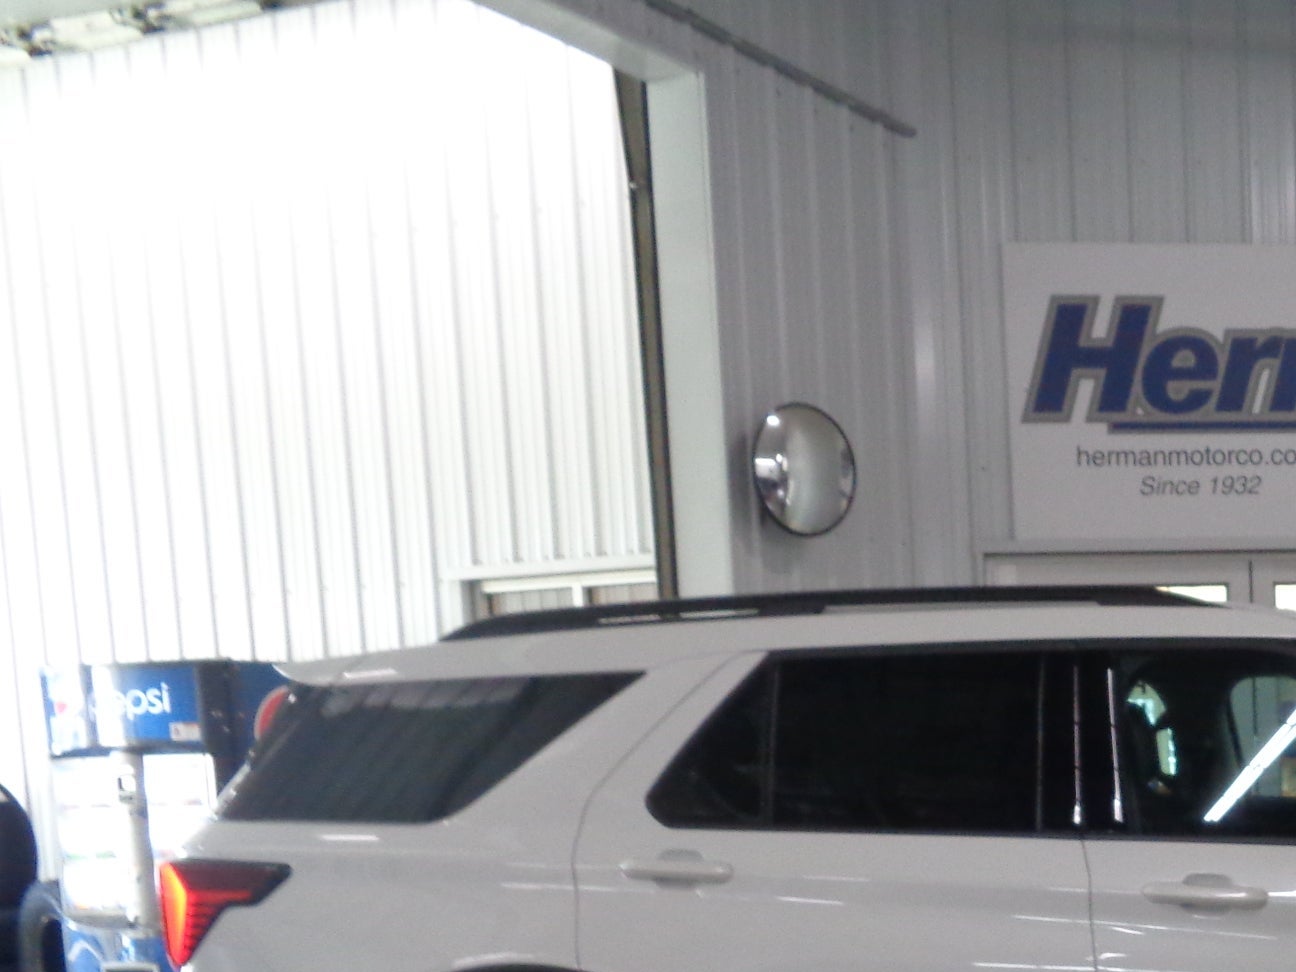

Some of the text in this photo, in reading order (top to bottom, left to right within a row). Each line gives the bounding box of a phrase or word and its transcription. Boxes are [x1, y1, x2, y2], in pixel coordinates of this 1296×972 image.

[1140, 476, 1262, 496] Since 1932
[93, 682, 171, 721] psi
